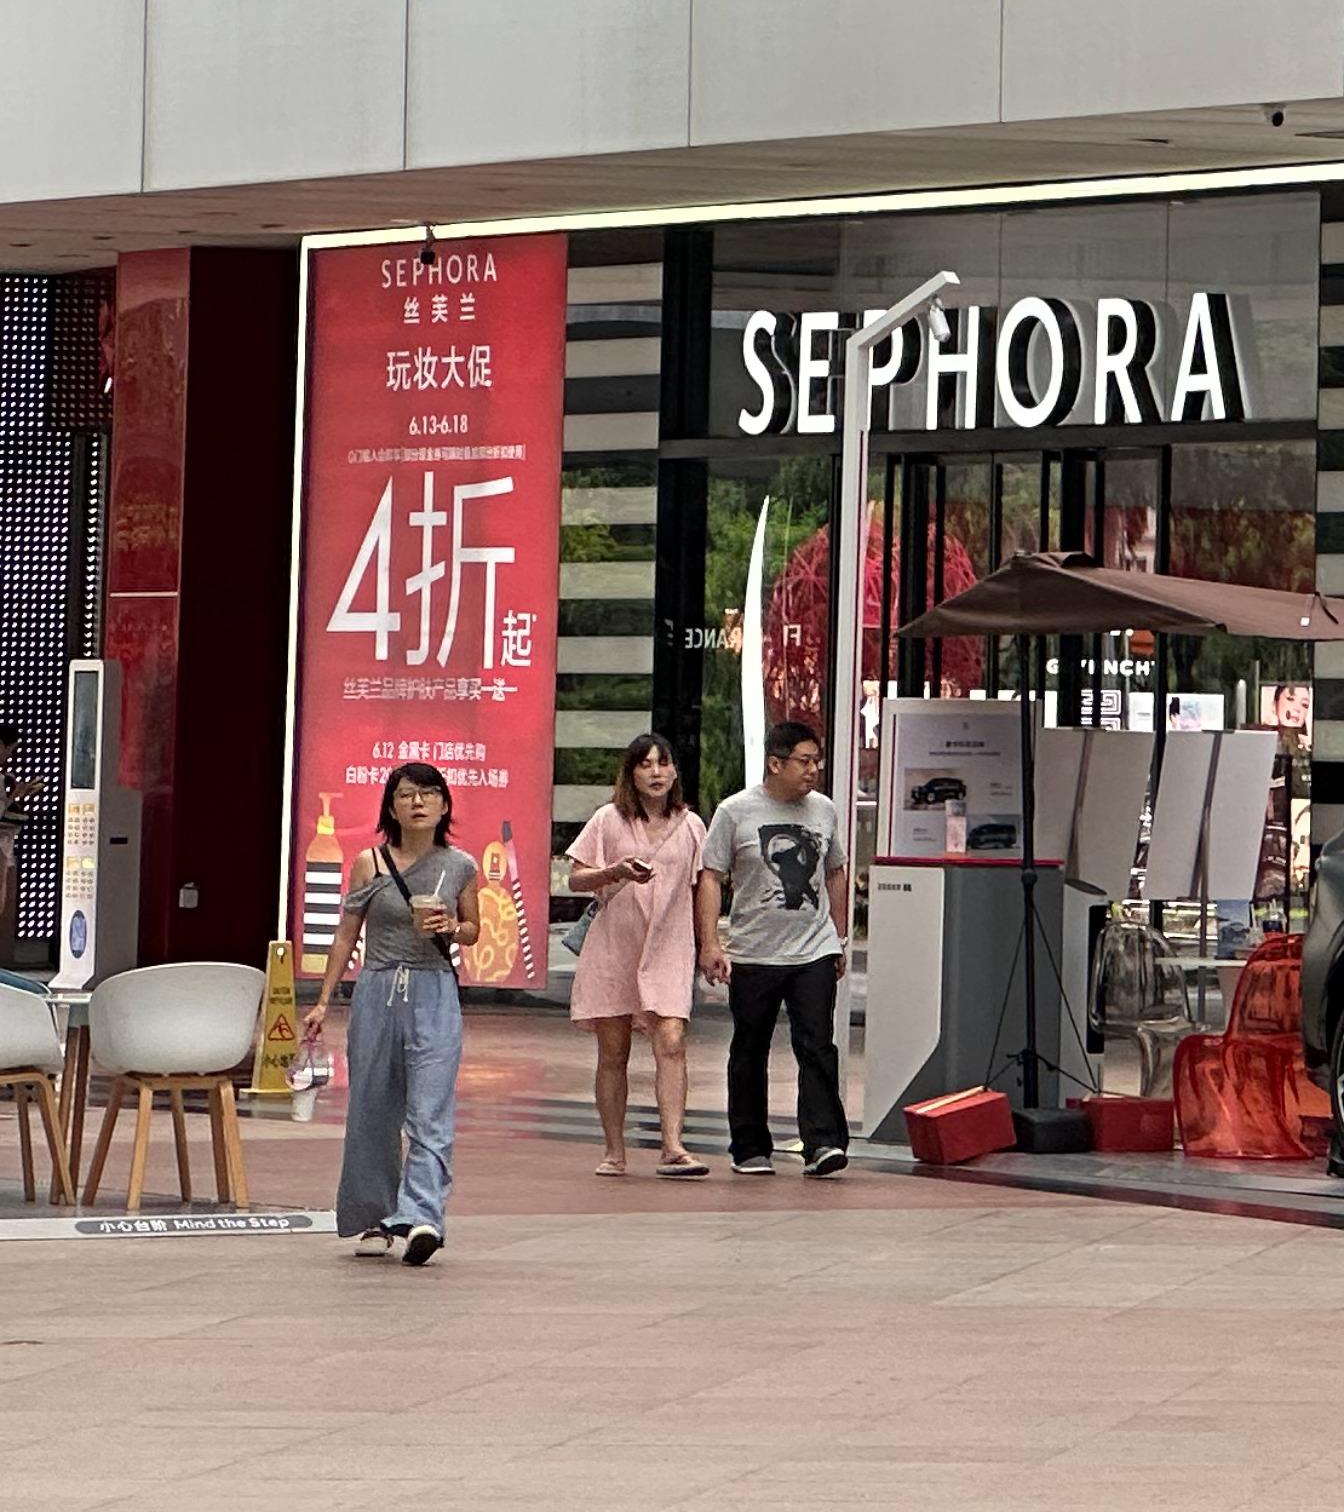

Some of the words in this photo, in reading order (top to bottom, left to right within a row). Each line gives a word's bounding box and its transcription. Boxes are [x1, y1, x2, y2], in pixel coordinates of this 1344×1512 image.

[381, 252, 498, 289] SEPHORA
[403, 293, 476, 324] 丝芙兰
[386, 344, 493, 391] 玩妆大促
[738, 293, 1238, 436] SEPHORA
[409, 414, 468, 436] 6.13-6.18
[372, 741, 394, 759] 6.12
[100, 1219, 167, 1233] 小心台阶
[174, 1218, 216, 1231] Mind
[218, 1218, 246, 1230] the
[250, 1216, 290, 1229] Step
